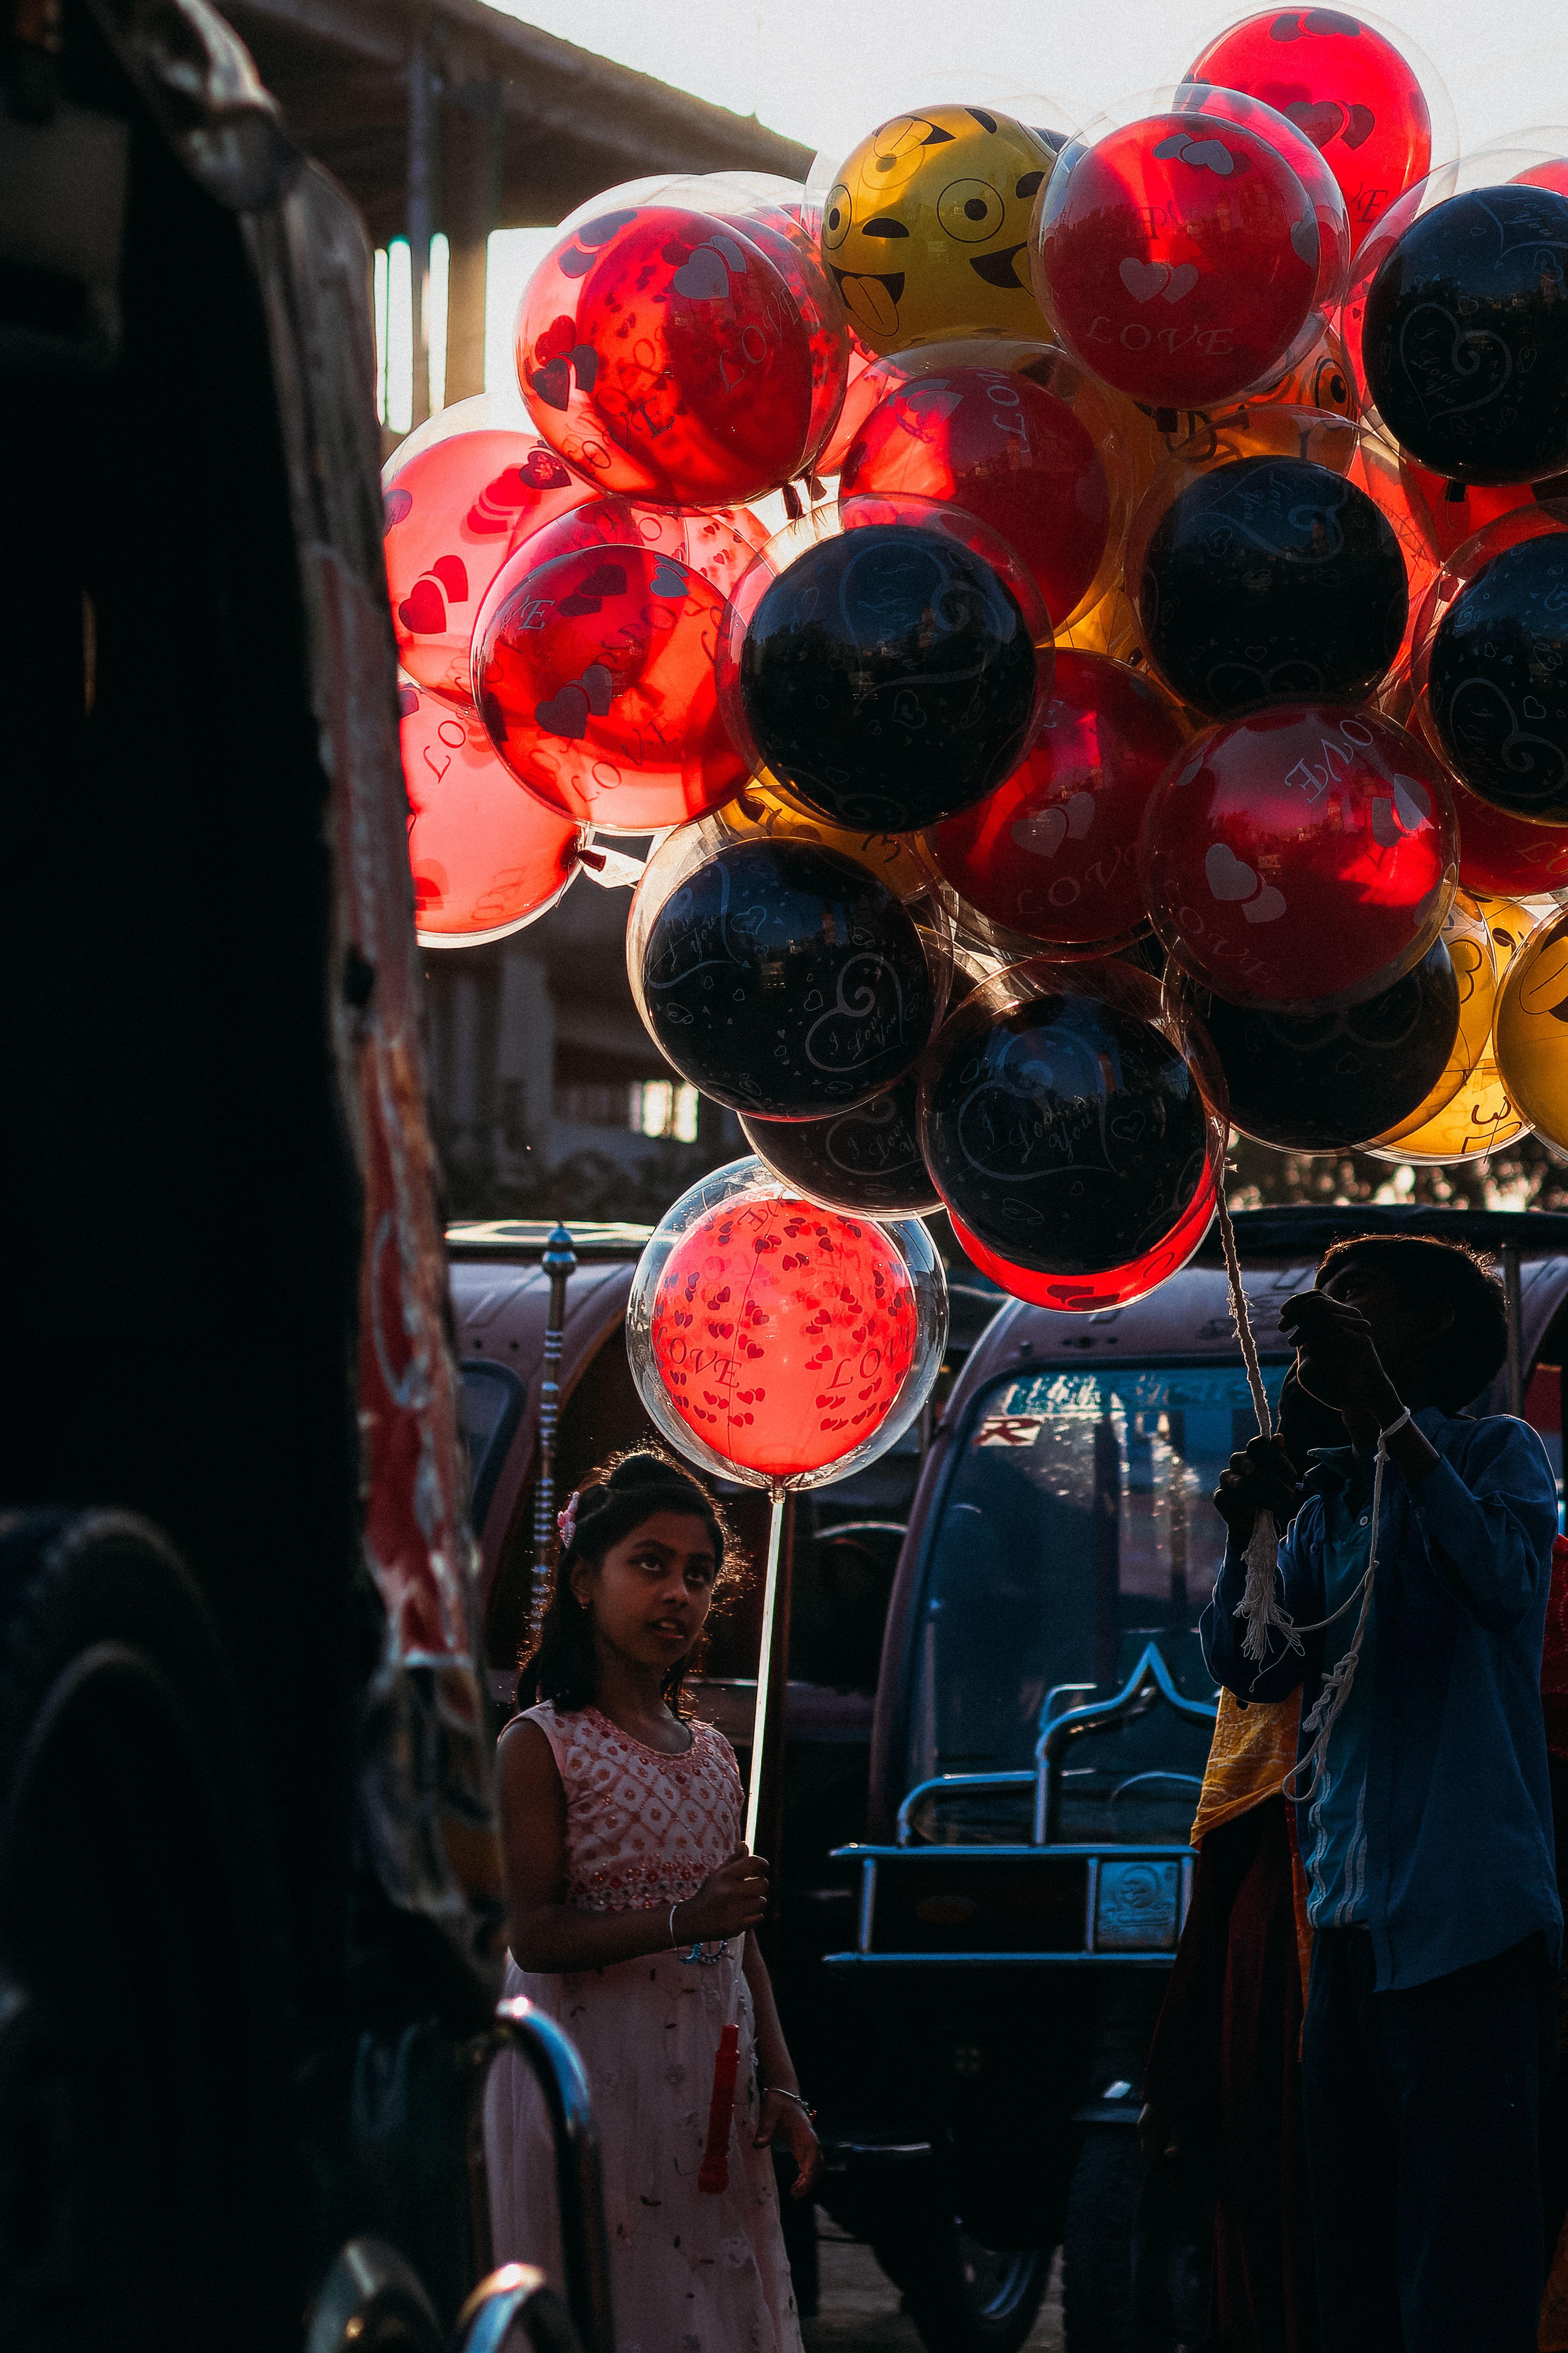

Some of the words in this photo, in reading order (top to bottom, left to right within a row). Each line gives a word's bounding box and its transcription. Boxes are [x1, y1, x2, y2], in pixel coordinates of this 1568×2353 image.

[1084, 316, 1234, 355] LOVE
[964, 364, 1028, 442] LOV
[1285, 713, 1387, 803] LOVE
[654, 1325, 742, 1388] LOVE
